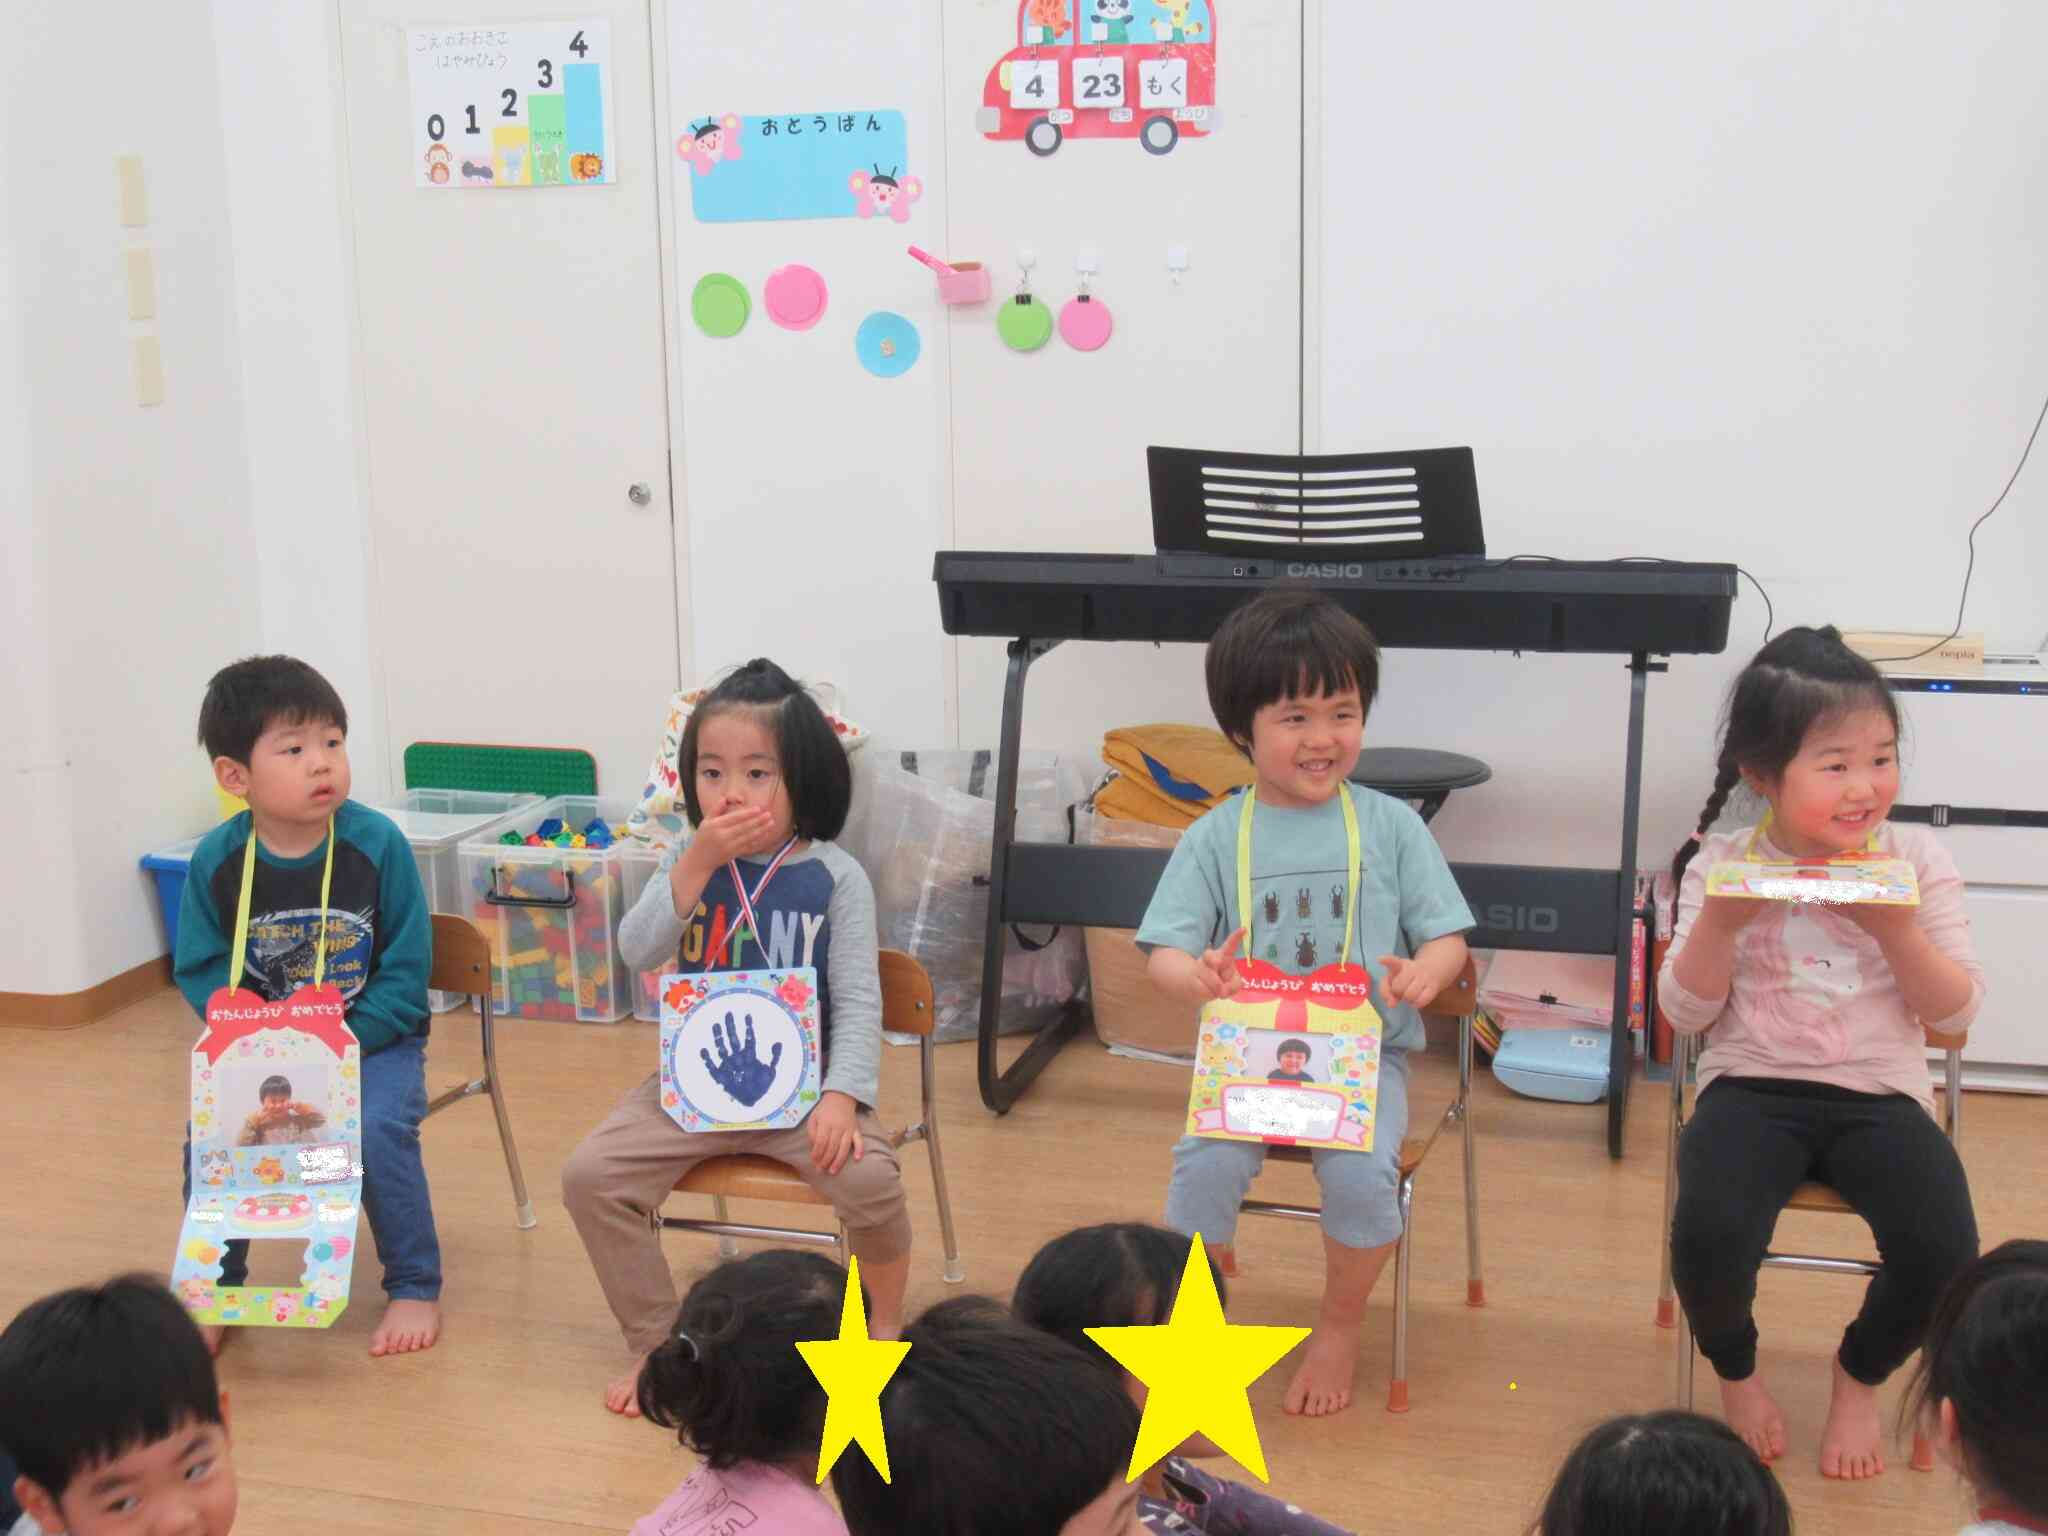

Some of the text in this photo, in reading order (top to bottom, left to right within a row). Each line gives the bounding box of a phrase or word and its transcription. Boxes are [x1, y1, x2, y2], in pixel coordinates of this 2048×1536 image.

[569, 31, 589, 58] 4
[537, 58, 553, 89] 3
[1025, 75, 1045, 98] 4
[1082, 73, 1122, 99] 23
[1147, 76, 1184, 96] もく
[501, 88, 518, 117] 2
[427, 114, 445, 141] 0
[465, 105, 481, 134] 1
[761, 114, 881, 136] おとうばん
[1287, 562, 1363, 579] CASIO
[1474, 904, 1558, 933] SIO
[768, 909, 825, 968] NY
[1310, 980, 1368, 995] おめでとう
[210, 1005, 285, 1022] おたんじょうび
[290, 1003, 343, 1018] おめでとう
